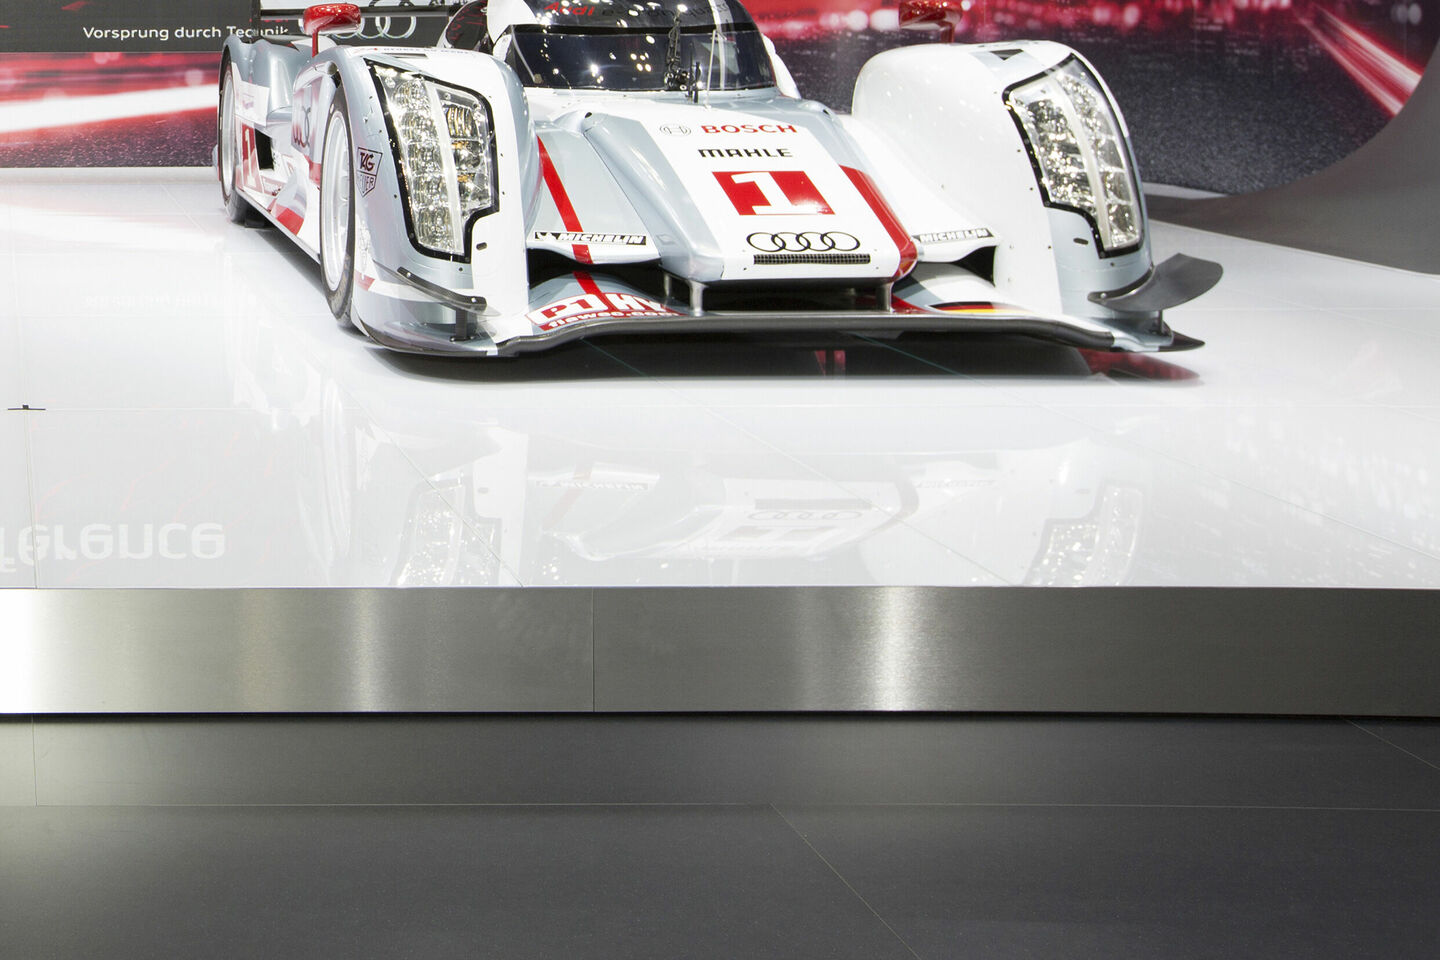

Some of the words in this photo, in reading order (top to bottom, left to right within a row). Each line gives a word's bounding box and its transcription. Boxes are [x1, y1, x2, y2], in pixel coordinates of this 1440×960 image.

[83, 26, 169, 40] Vorsprung
[174, 26, 222, 39] durch
[701, 124, 798, 134] BOSCH
[697, 148, 794, 158] MAHLE
[730, 171, 812, 215] 1
[560, 232, 643, 245] MICHELIN
